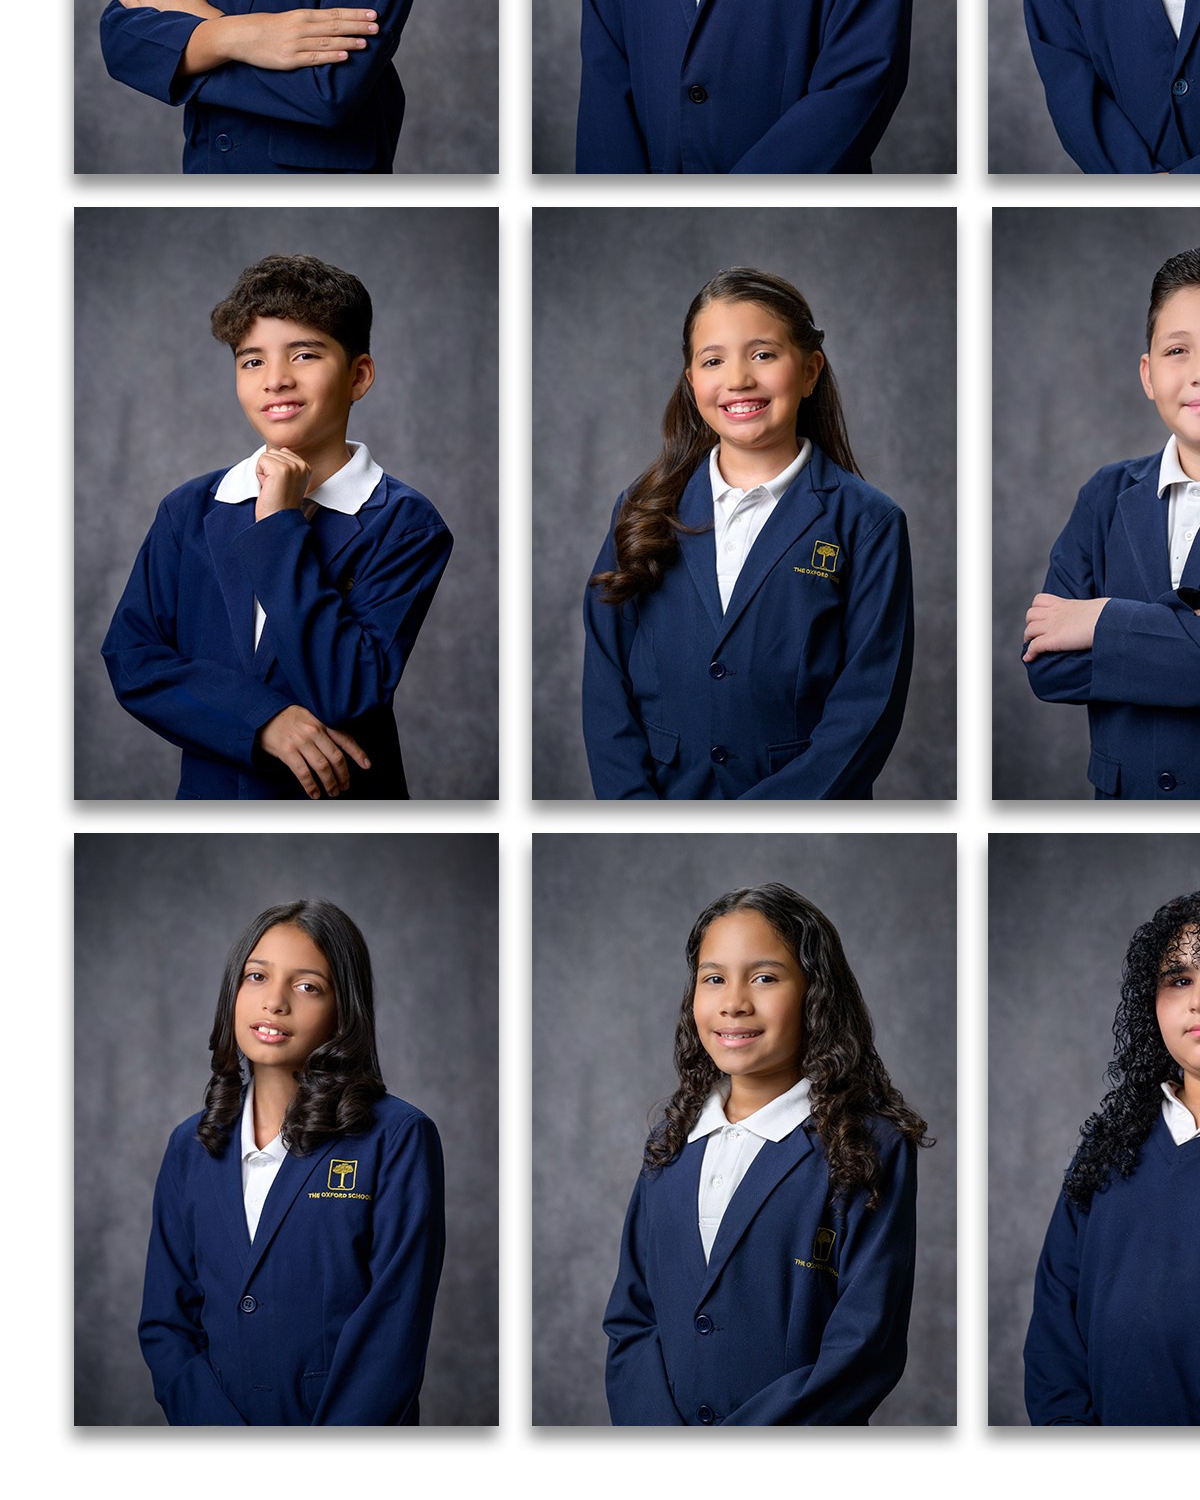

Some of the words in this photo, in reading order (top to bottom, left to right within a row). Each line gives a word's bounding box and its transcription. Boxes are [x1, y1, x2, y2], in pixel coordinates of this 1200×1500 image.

[806, 569, 828, 579] OXFORD
[321, 1192, 347, 1200] OXFORD
[795, 1258, 806, 1267] THE
